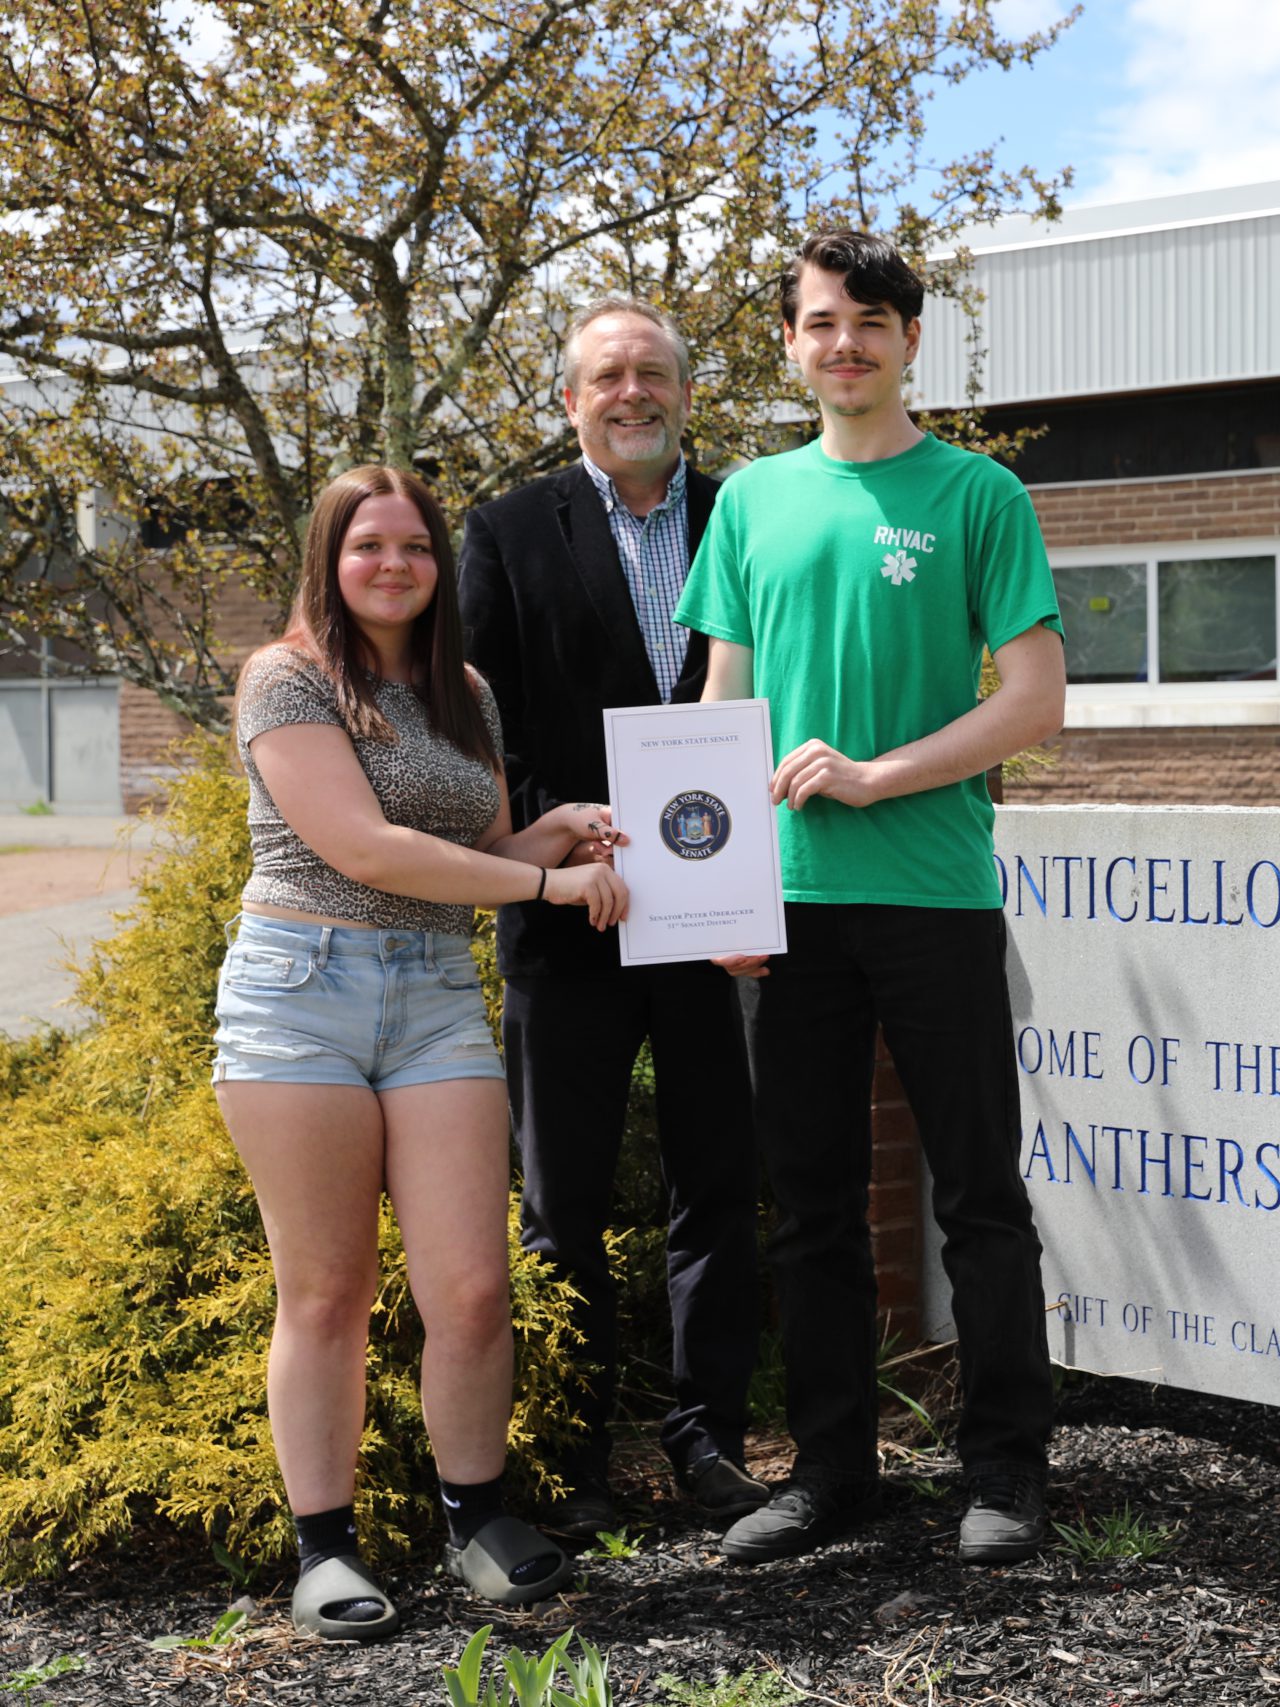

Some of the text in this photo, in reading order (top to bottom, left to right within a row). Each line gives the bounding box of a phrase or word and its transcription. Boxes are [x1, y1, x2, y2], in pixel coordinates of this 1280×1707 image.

[873, 525, 936, 553] RHVAC
[661, 739, 683, 747] YORK
[685, 737, 708, 745] STATE
[709, 735, 739, 743] SENATE
[664, 793, 726, 820] NEW YORK STATE
[680, 848, 713, 858] SENATE
[1018, 1026, 1104, 1079] OME
[1128, 1035, 1180, 1086] OF
[1057, 1292, 1108, 1327] GIFT
[1123, 1303, 1153, 1334] OF
[1167, 1310, 1216, 1346] THE
